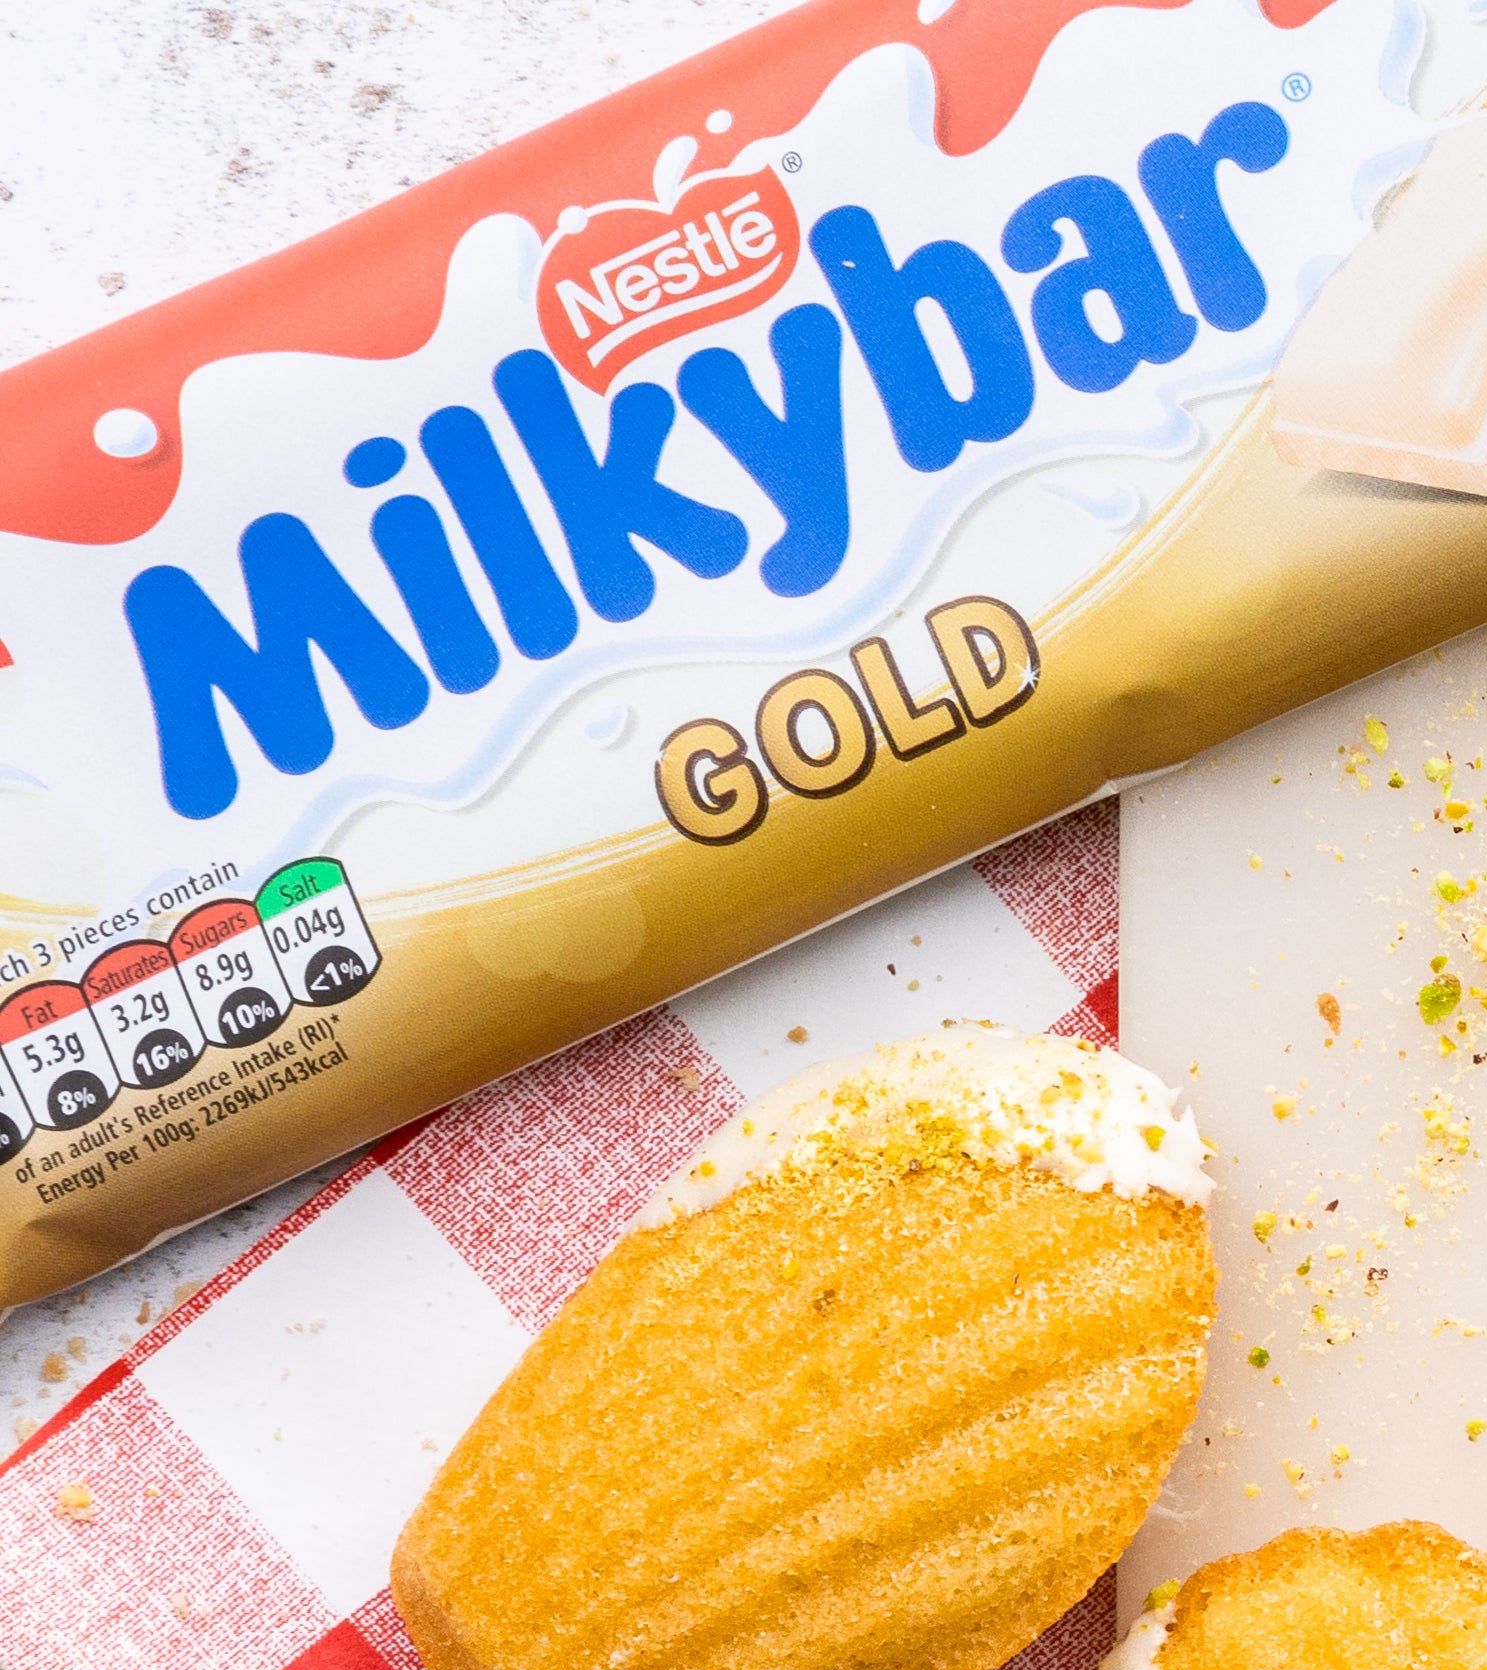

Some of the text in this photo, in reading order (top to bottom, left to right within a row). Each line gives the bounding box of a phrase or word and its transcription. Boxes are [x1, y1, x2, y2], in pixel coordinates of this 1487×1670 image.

[555, 191, 777, 339] Nestlé
[120, 101, 1290, 819] Milkybar
[655, 595, 1040, 845] GOLD
[279, 874, 321, 907] Salt
[0, 861, 239, 983] ch 3 pieces contain
[179, 911, 248, 954] Sugars
[273, 906, 346, 954] 0.04g
[88, 950, 169, 999] Saturates
[196, 951, 254, 991] 8.9g
[310, 958, 364, 991] <1%
[21, 1000, 58, 1029] Fat
[111, 991, 170, 1033] 3.2g
[222, 1000, 275, 1035] 10%
[22, 1032, 86, 1073] 5.3g
[136, 1042, 189, 1076] 16%
[16, 1158, 36, 1183] of
[40, 1150, 65, 1172] an
[70, 1116, 134, 1159] adult's
[134, 1072, 232, 1125] Reference
[233, 1040, 297, 1079] Intake
[57, 1087, 96, 1115] 8%
[36, 1041, 349, 1204] Energy Per 100g: 2269kJ/543kcal
